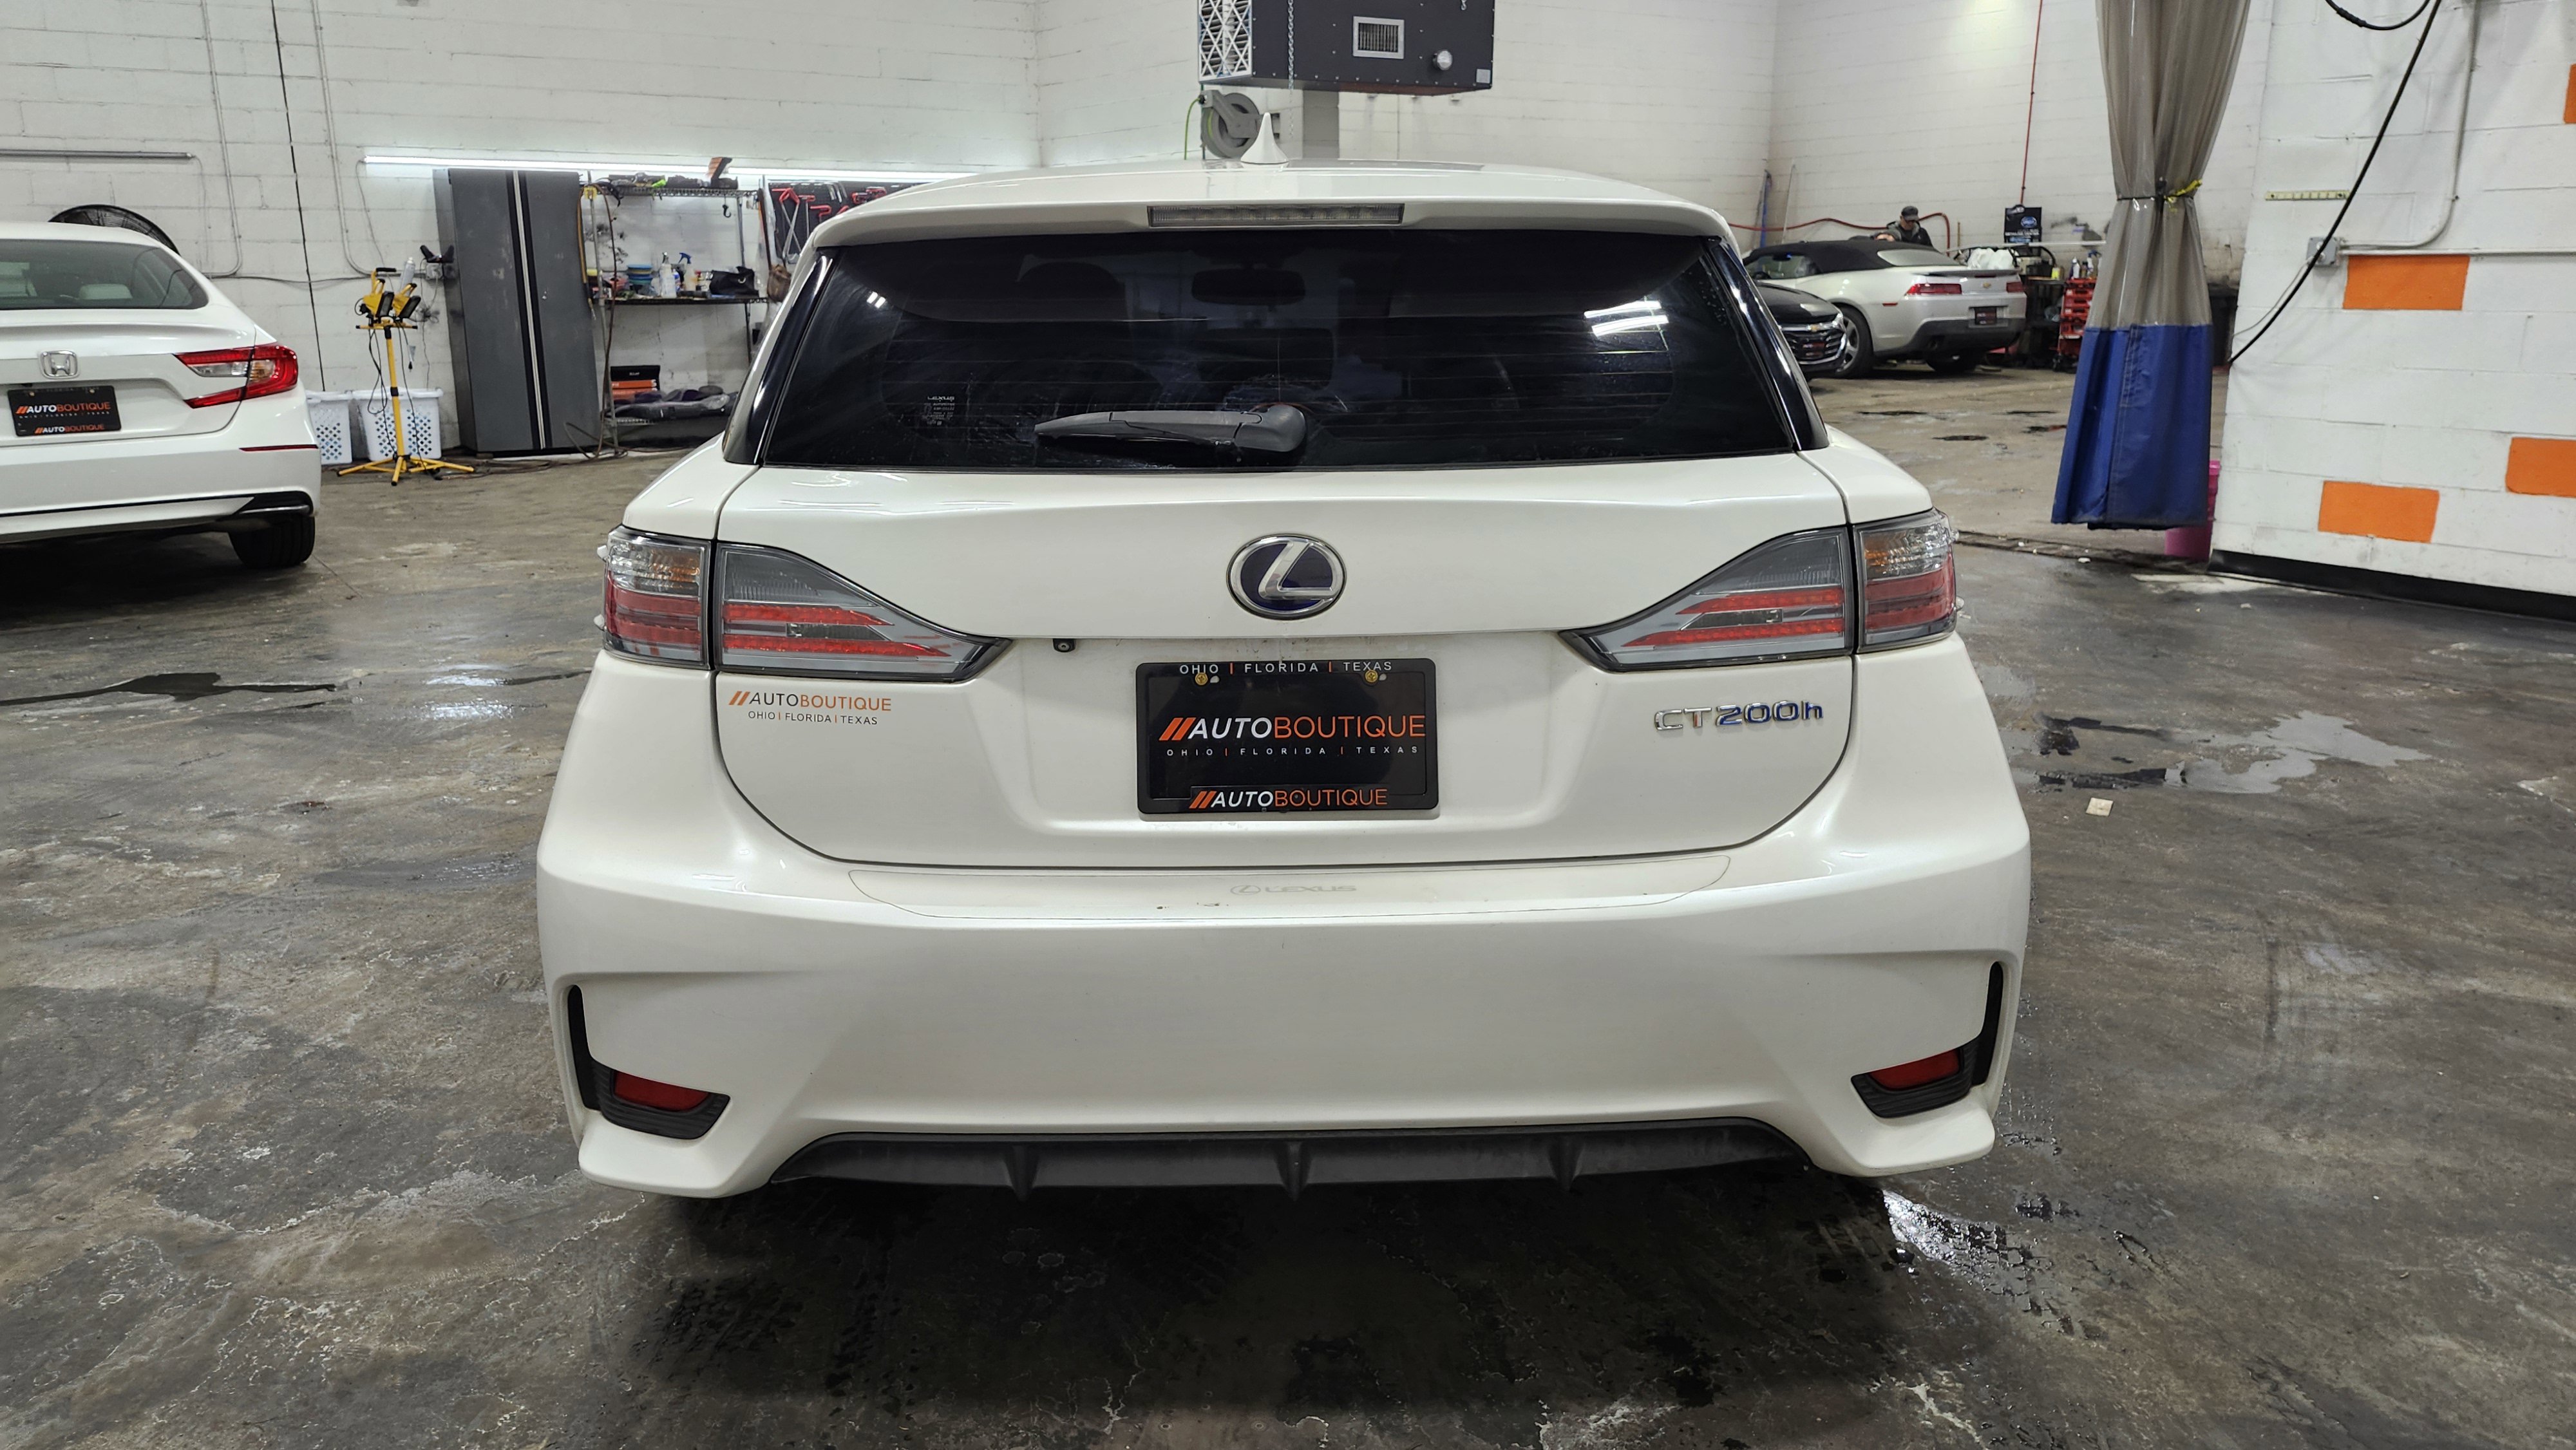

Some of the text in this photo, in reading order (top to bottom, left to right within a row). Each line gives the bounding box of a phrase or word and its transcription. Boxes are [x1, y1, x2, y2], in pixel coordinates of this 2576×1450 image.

[26, 402, 111, 414] AUTOBOUTIQUE
[1179, 661, 1392, 675] OHIO FLORIDA TEXAS
[749, 692, 892, 711] AUTOBOUTIQUE
[748, 710, 878, 725] OHIO FLORIDA TEXAS
[1654, 699, 1824, 731] CT200h
[1188, 715, 1426, 740] AUTOBOUTIQUE
[1166, 746, 1419, 757] OHIO FLORIDA TEXAS
[1211, 789, 1388, 808] AUTOBOUTIQUE
